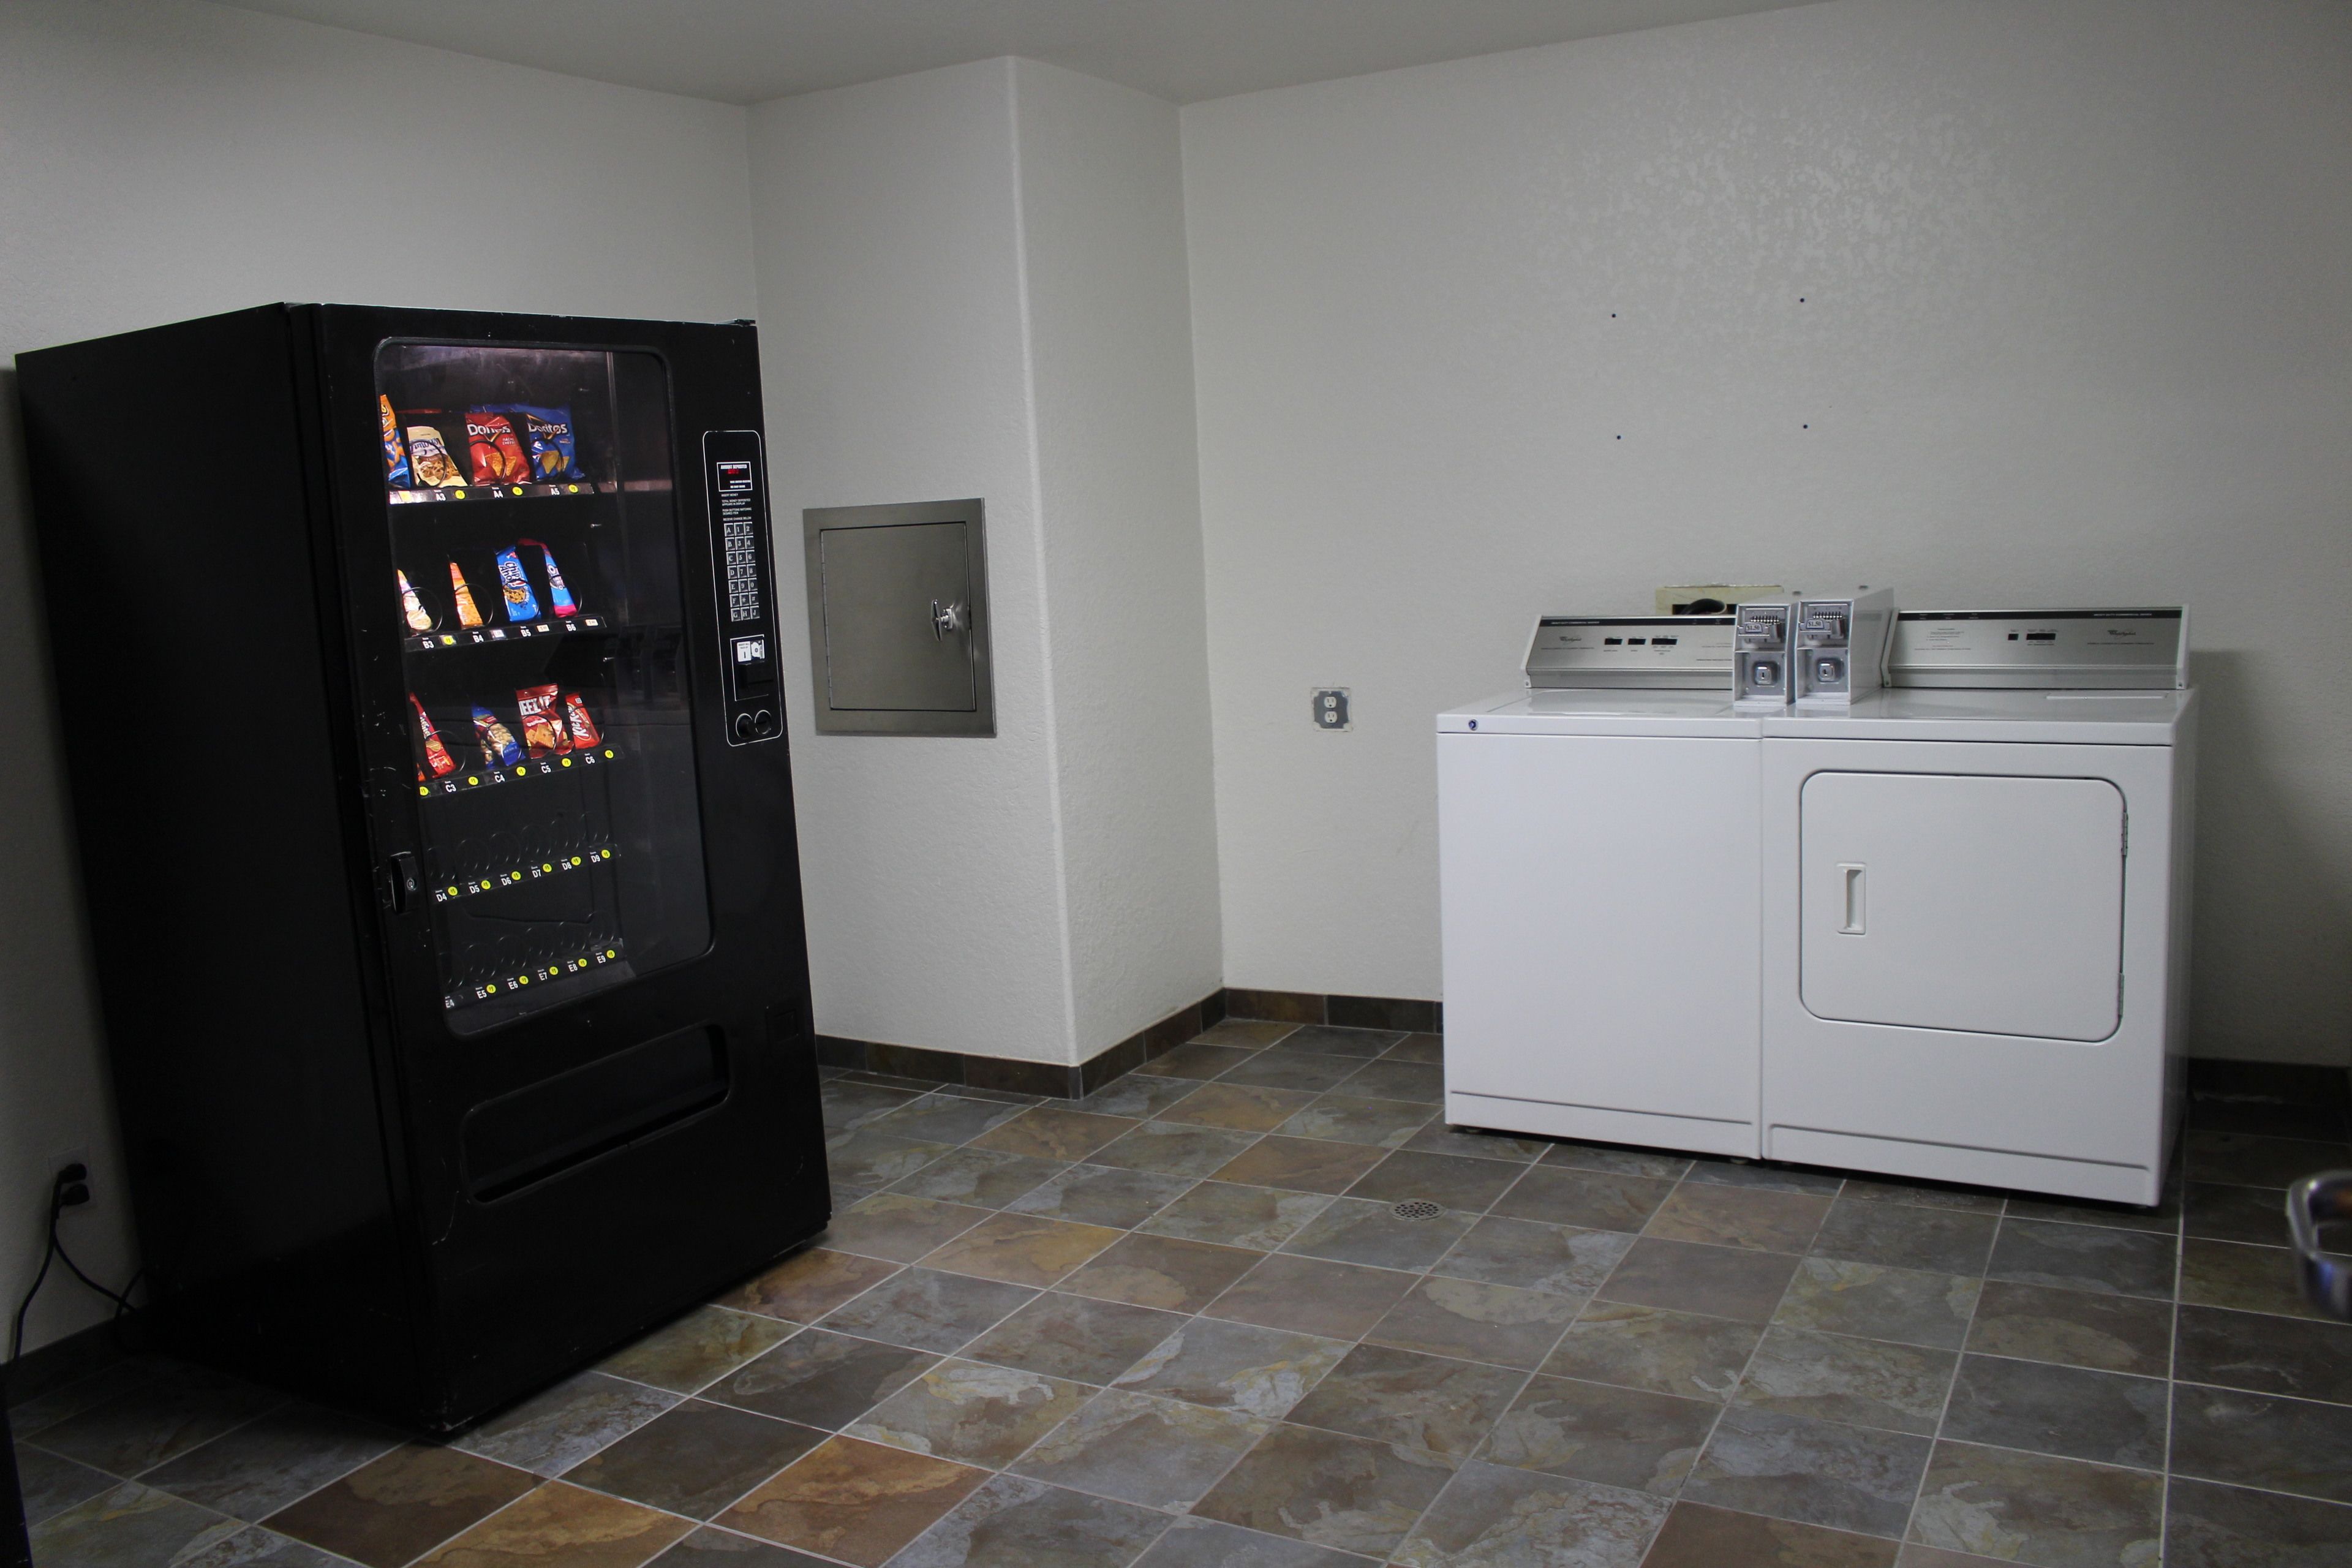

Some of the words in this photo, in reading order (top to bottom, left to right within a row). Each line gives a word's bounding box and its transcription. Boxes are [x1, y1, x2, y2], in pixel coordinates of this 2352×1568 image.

[527, 422, 568, 434] Doritos
[493, 490, 503, 499] A4
[551, 488, 560, 496] A5
[435, 493, 447, 502] A3
[472, 635, 484, 643] B4
[423, 641, 434, 649] B3
[585, 756, 595, 764] C6
[541, 765, 551, 774] C5
[494, 774, 505, 783] C4
[445, 784, 456, 793] C3
[590, 854, 601, 863] D9
[561, 861, 572, 870] D8
[532, 869, 542, 878] D7
[500, 876, 512, 886] D6
[469, 885, 480, 894] D5
[436, 892, 447, 902] D4
[597, 954, 606, 964] E9
[568, 963, 578, 973] E8
[538, 971, 548, 981] E7
[508, 981, 518, 990] E6
[476, 990, 488, 999] E5
[445, 998, 454, 1008] E4
